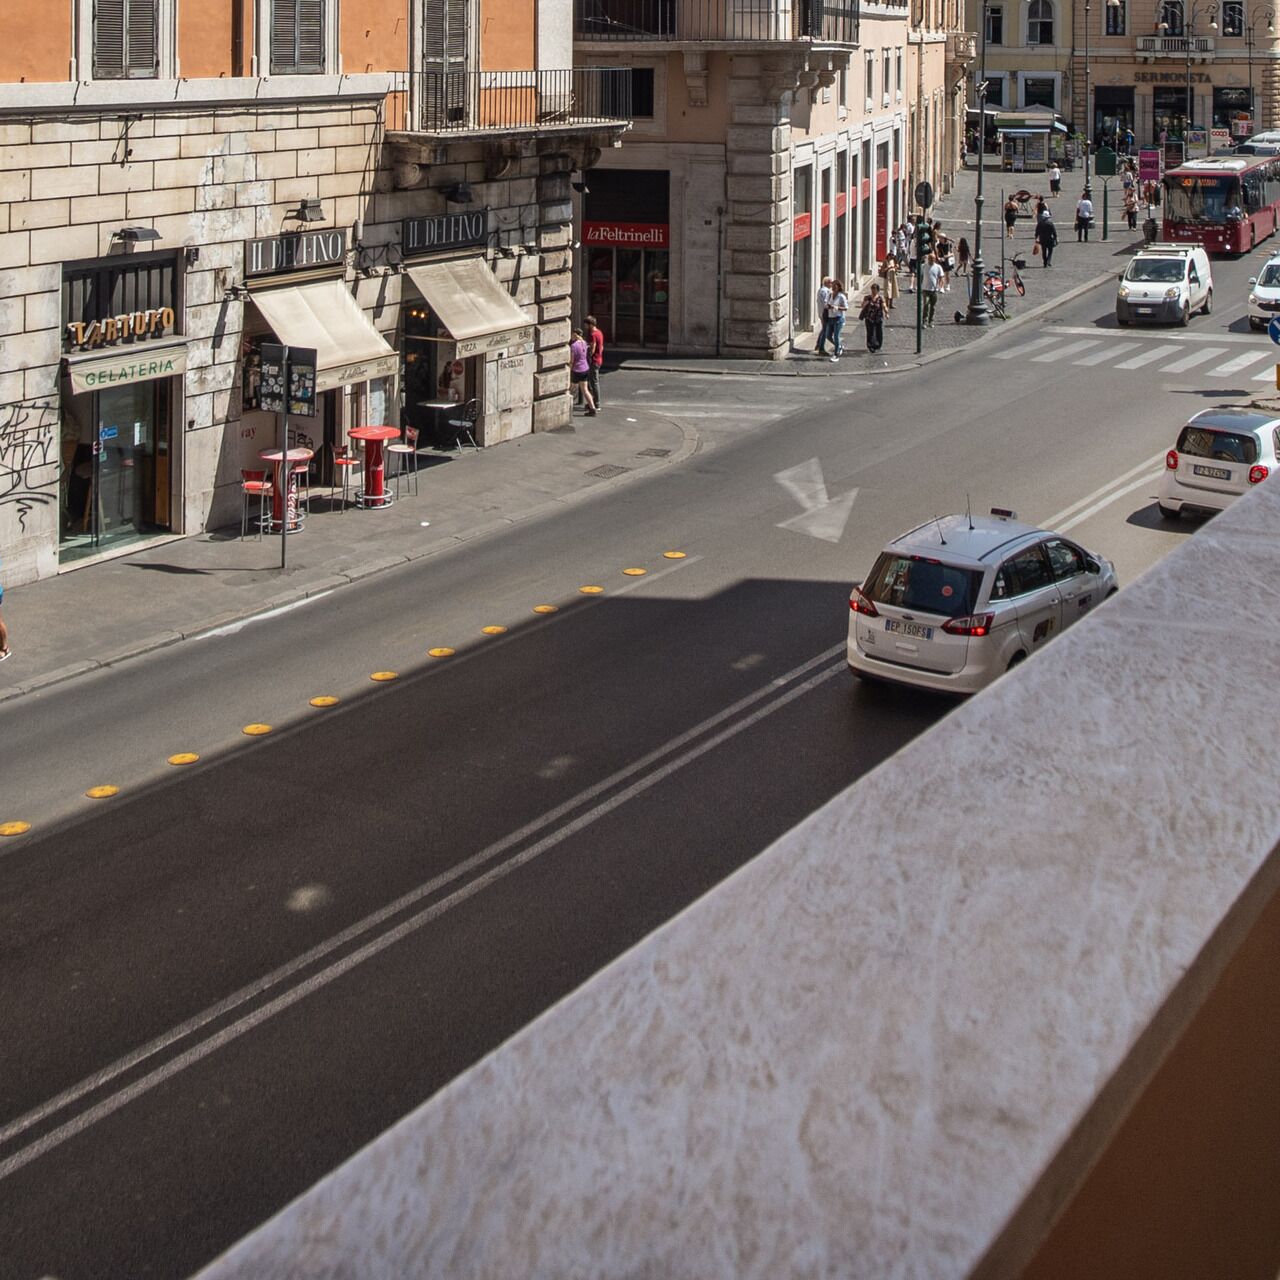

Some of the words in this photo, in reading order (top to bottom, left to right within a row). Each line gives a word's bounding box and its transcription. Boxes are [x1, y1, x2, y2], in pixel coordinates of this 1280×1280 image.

[409, 221, 421, 248] IL
[425, 213, 483, 244] DELFINO
[587, 226, 663, 243] laFeltrinelli
[251, 242, 268, 271] IL
[271, 233, 342, 269] DELFINO
[68, 307, 175, 346] TARTUFO
[85, 360, 174, 386] GELATERIA
